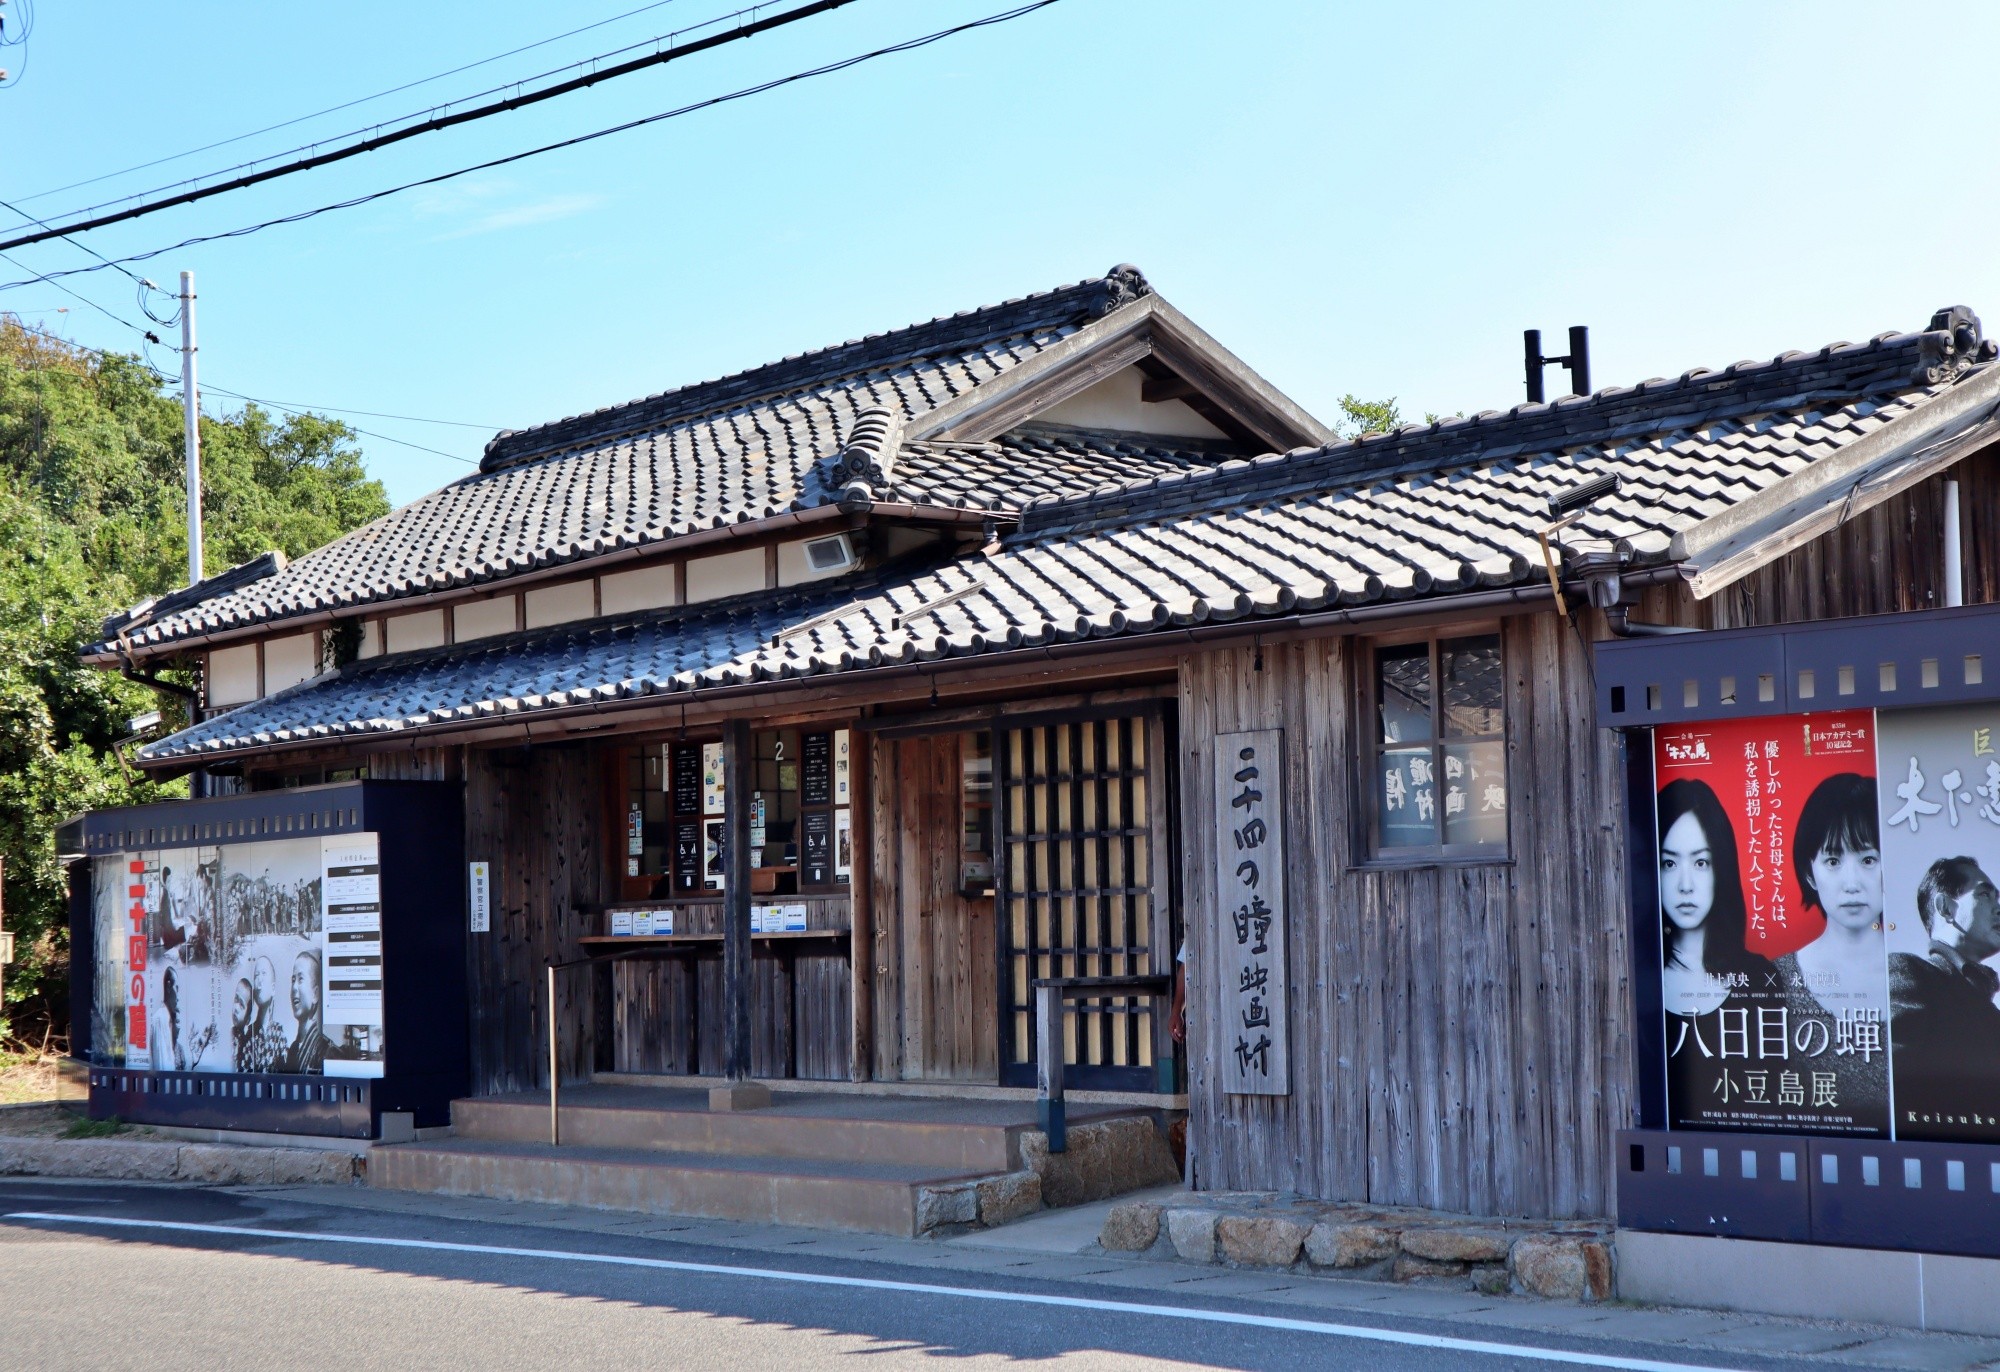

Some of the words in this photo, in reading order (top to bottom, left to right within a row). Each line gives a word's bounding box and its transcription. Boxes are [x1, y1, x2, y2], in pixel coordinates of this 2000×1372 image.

[775, 741, 784, 761] 2
[1813, 728, 1866, 742] 日本アカデミー賞
[651, 756, 656, 776] 1
[1744, 741, 1767, 939] 私を誘拐した人でした。
[1765, 739, 1787, 929] 優しかったお母さんは、
[1230, 746, 1272, 1078] 二十四の瞳映画村
[128, 860, 148, 1051] 二十四の瞳
[1713, 1068, 1840, 1108] 小豆島展
[1908, 1110, 1996, 1125] Keisuke
